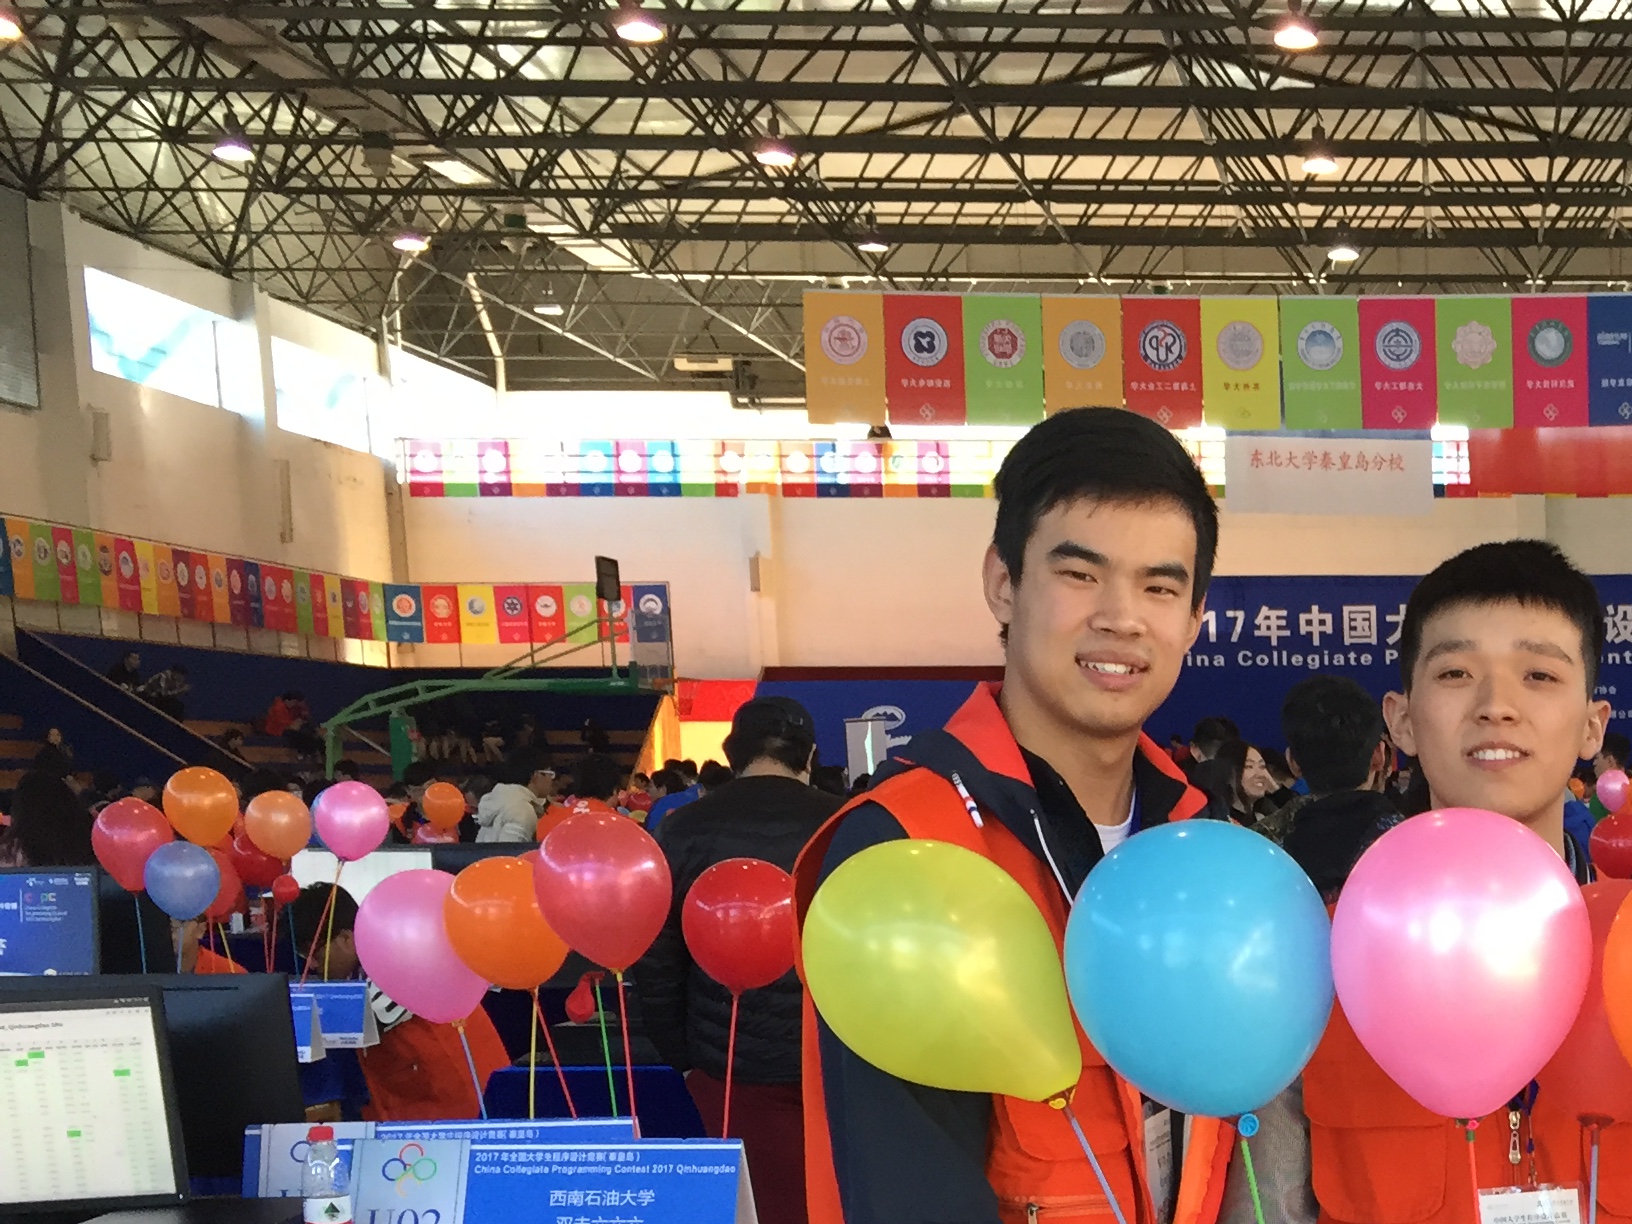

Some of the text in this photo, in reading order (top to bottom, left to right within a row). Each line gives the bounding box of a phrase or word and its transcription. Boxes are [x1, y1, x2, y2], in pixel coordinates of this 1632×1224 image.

[1250, 449, 1405, 471] 东北大学秦皇岛分校
[1187, 651, 1225, 667] ina
[1237, 650, 1373, 670] Collegiate
[474, 1163, 736, 1176] China Collegiate Programming Contest 2017 Qinhuangdao
[550, 1189, 656, 1207] 西南石油大学
